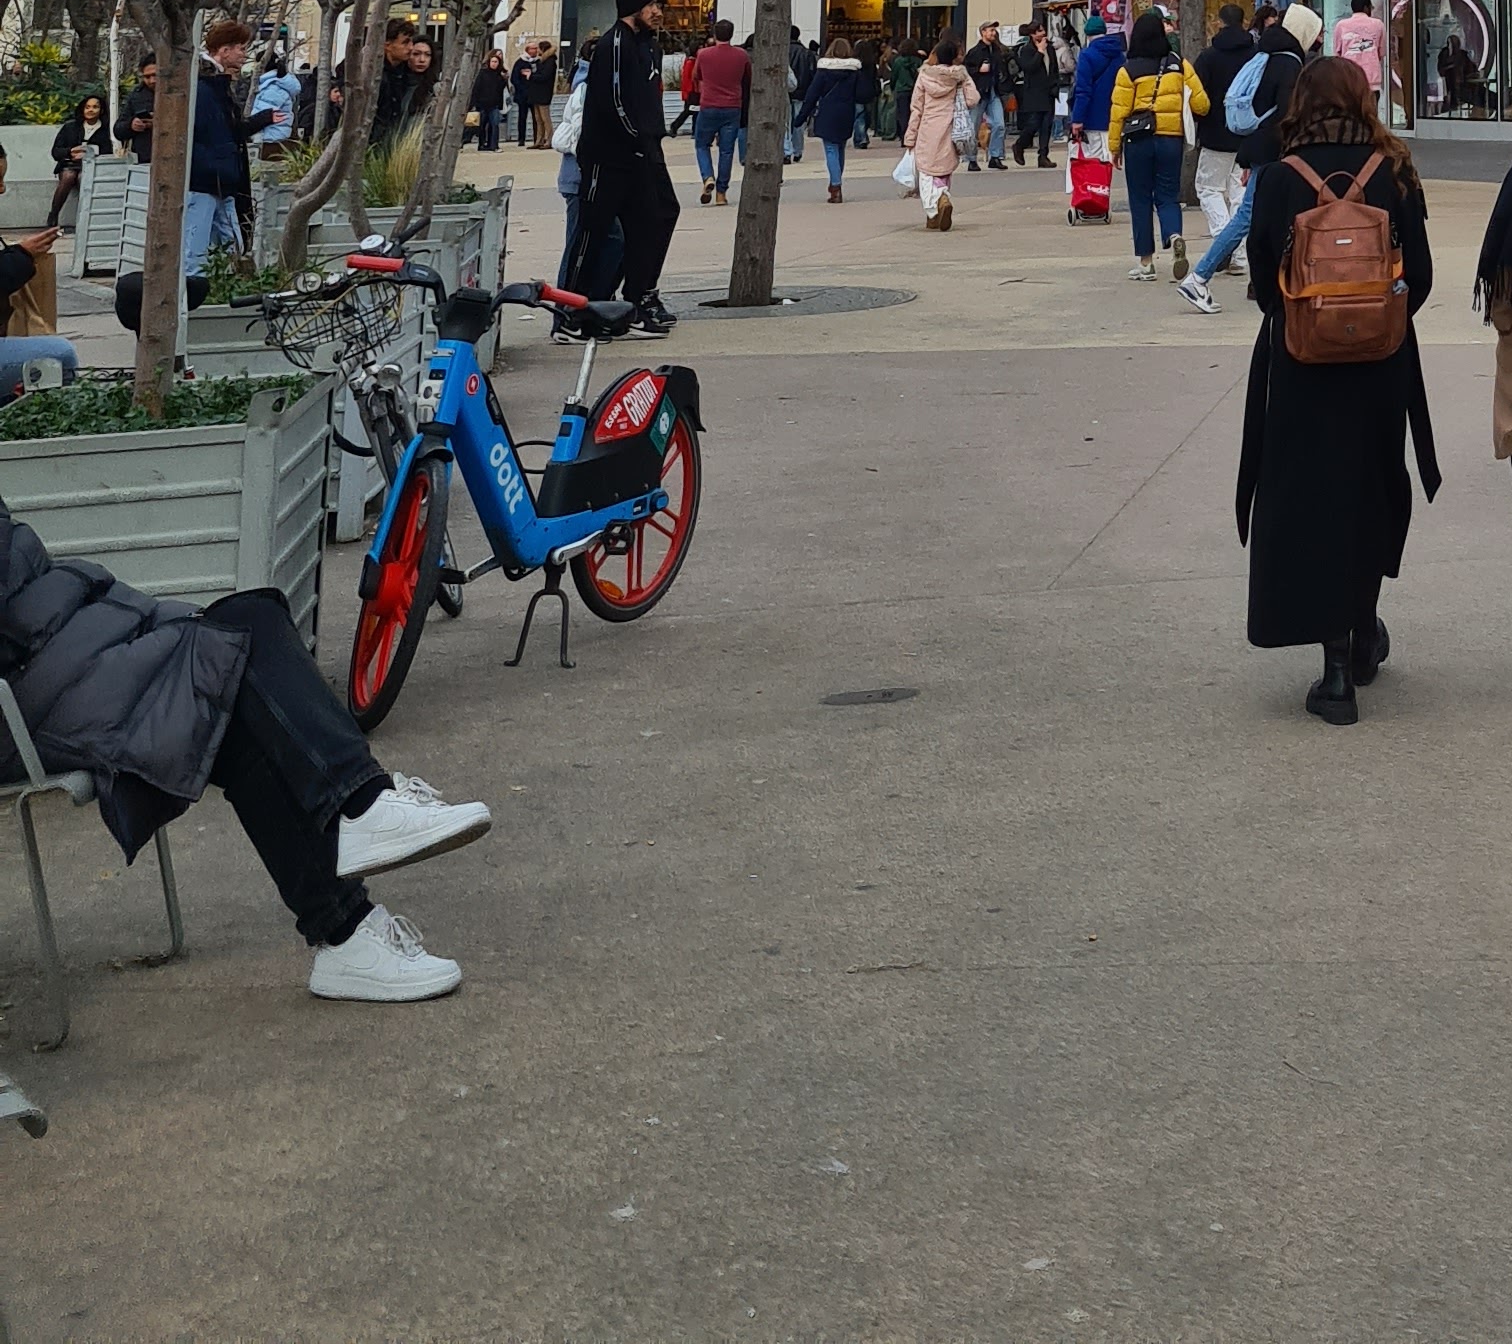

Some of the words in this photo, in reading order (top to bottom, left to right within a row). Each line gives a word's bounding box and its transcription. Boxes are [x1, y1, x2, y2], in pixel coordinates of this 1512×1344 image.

[604, 403, 623, 429] ESSAI
[623, 375, 659, 427] GRATUIT
[490, 442, 524, 515] dott
